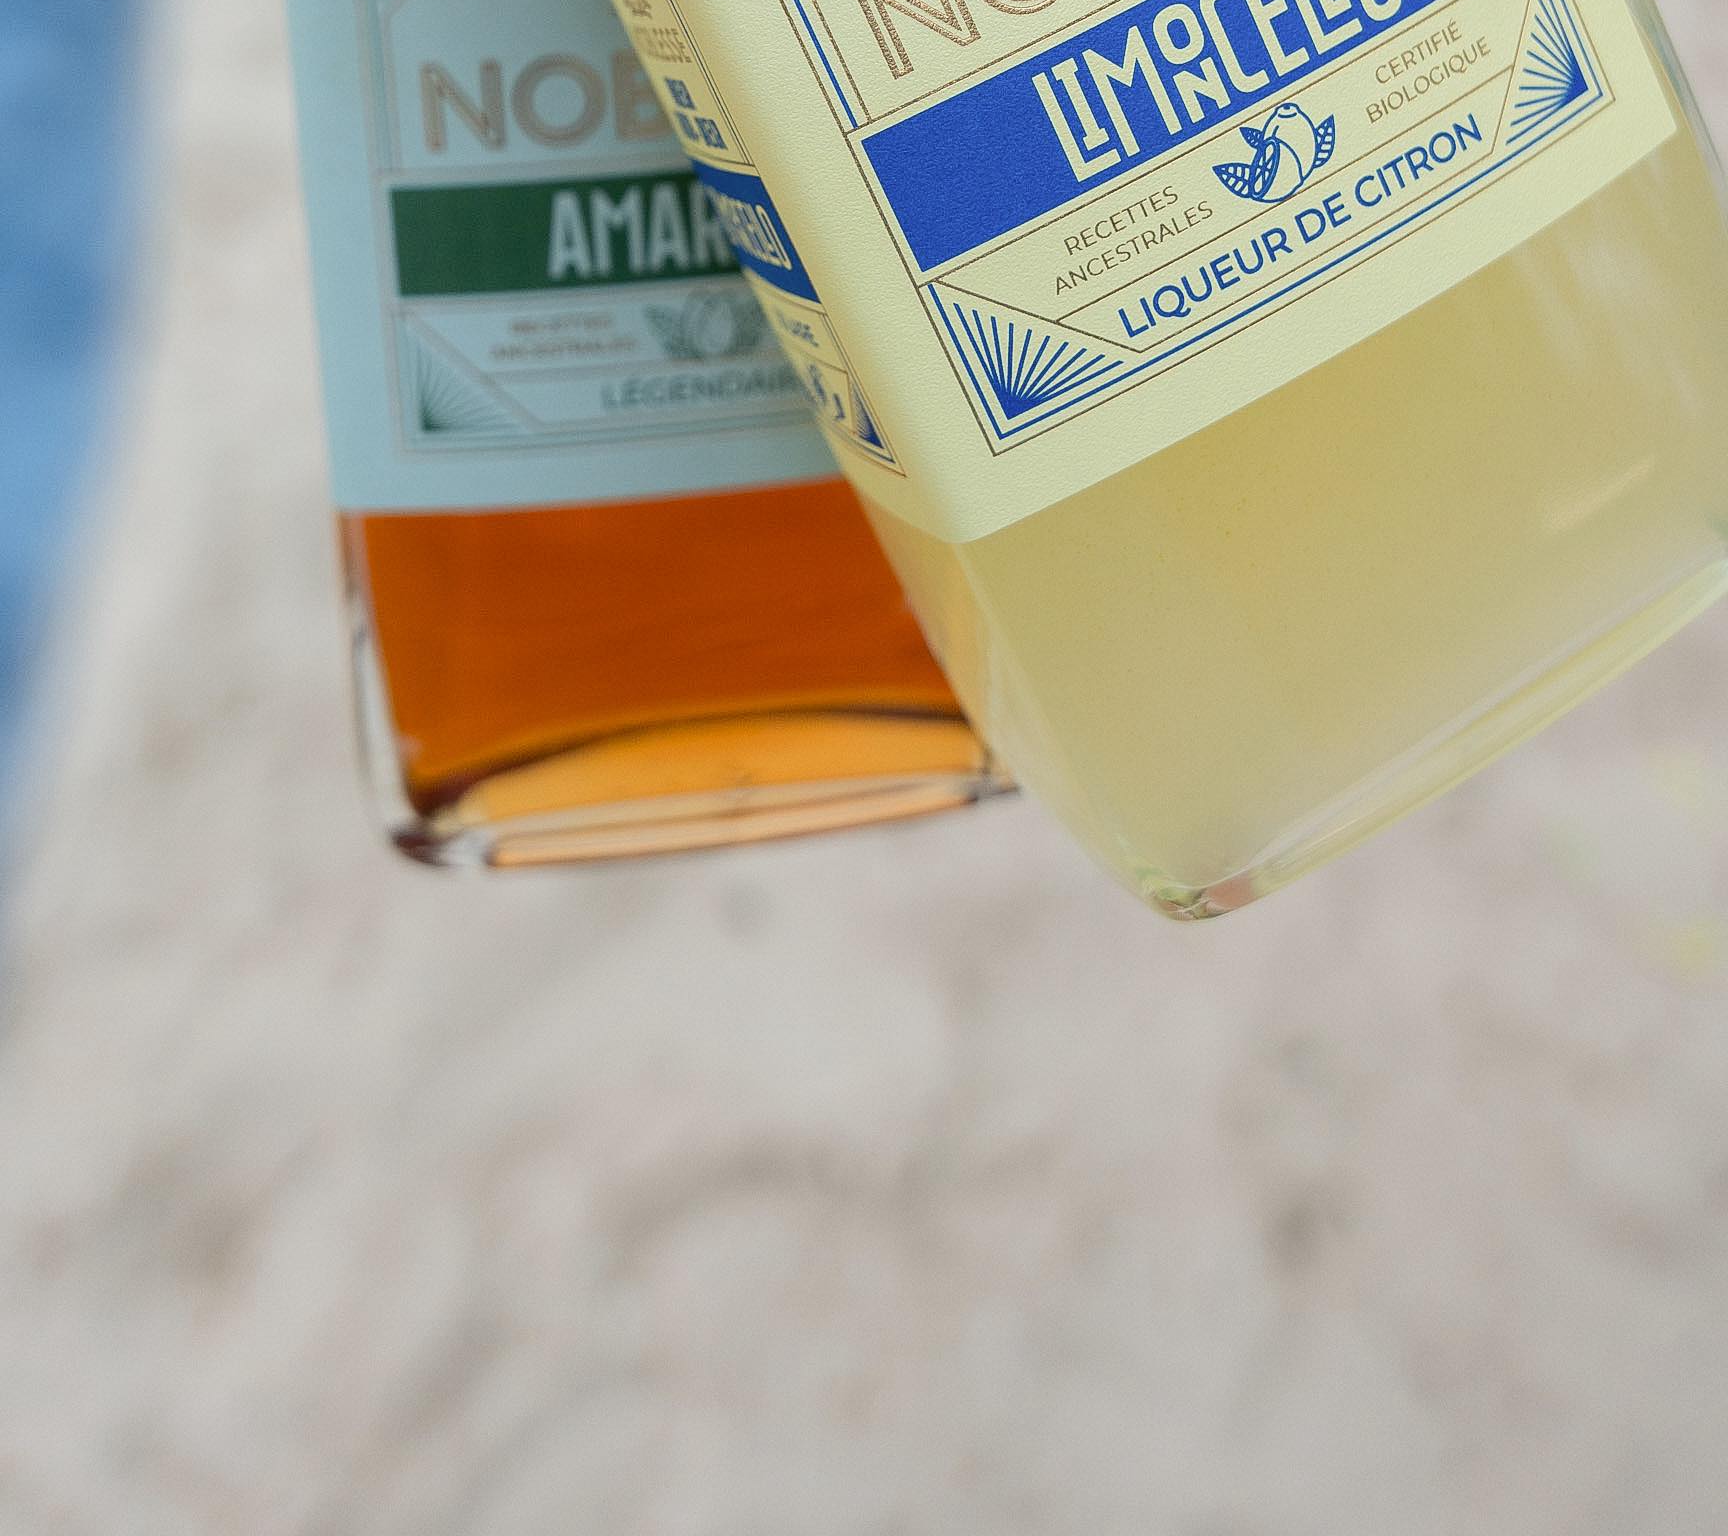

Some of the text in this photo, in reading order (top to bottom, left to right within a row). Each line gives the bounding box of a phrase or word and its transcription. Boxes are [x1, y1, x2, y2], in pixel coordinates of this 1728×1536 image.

[1365, 36, 1491, 124] BIOLOGIQUE
[1375, 18, 1462, 85] CERTIFIÉ
[419, 54, 674, 152] NOB
[547, 182, 735, 278] AMAR
[1055, 200, 1214, 296] ANCESTRALES
[1063, 185, 1179, 256] RECETTES
[1118, 113, 1482, 338] LIQUEUR DE CITRON
